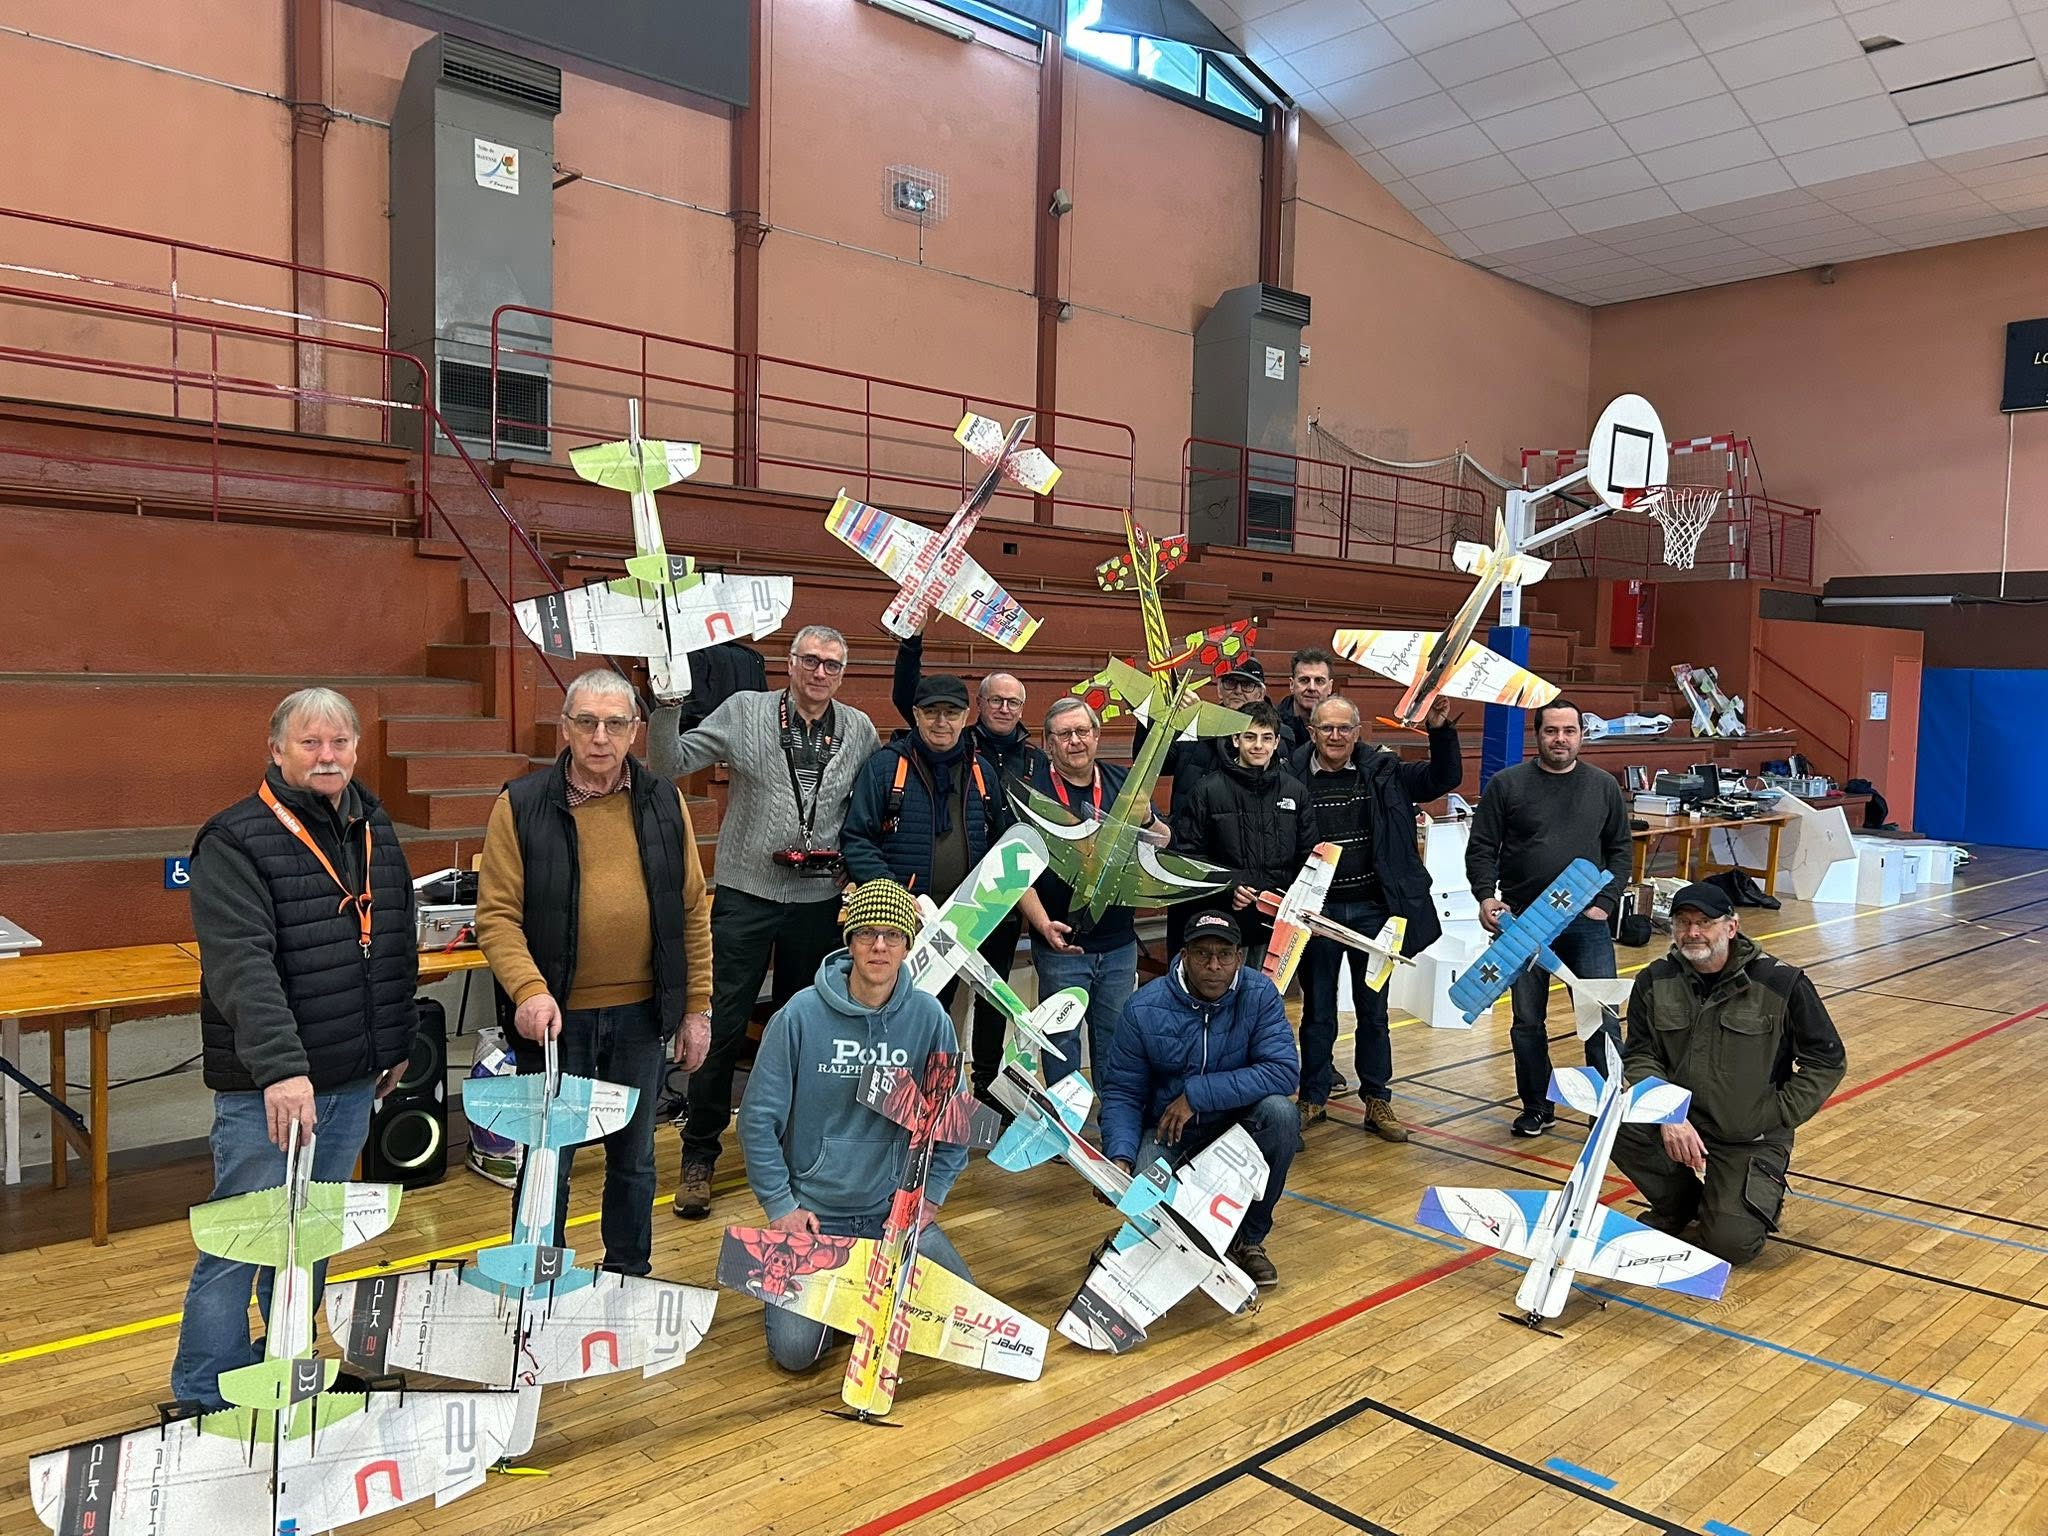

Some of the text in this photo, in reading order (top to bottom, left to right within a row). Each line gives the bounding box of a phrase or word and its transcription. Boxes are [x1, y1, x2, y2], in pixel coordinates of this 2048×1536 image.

[585, 599, 598, 652] FLIGHT
[1382, 632, 1420, 676] Inferno
[1461, 652, 1500, 697] Inferno
[1057, 1000, 1076, 1024] MPX
[817, 1063, 864, 1074] RALPH
[830, 1039, 908, 1066] Polo
[1617, 1250, 1692, 1268] laser
[369, 1279, 385, 1329] CLIK
[1077, 1294, 1111, 1325] CLIK
[1108, 1273, 1158, 1317] FLIGHT
[416, 1290, 432, 1371] FLIGHT
[847, 1318, 874, 1388] FLY
[86, 1444, 104, 1502] CLIK
[148, 1448, 163, 1536] FLIGHT
